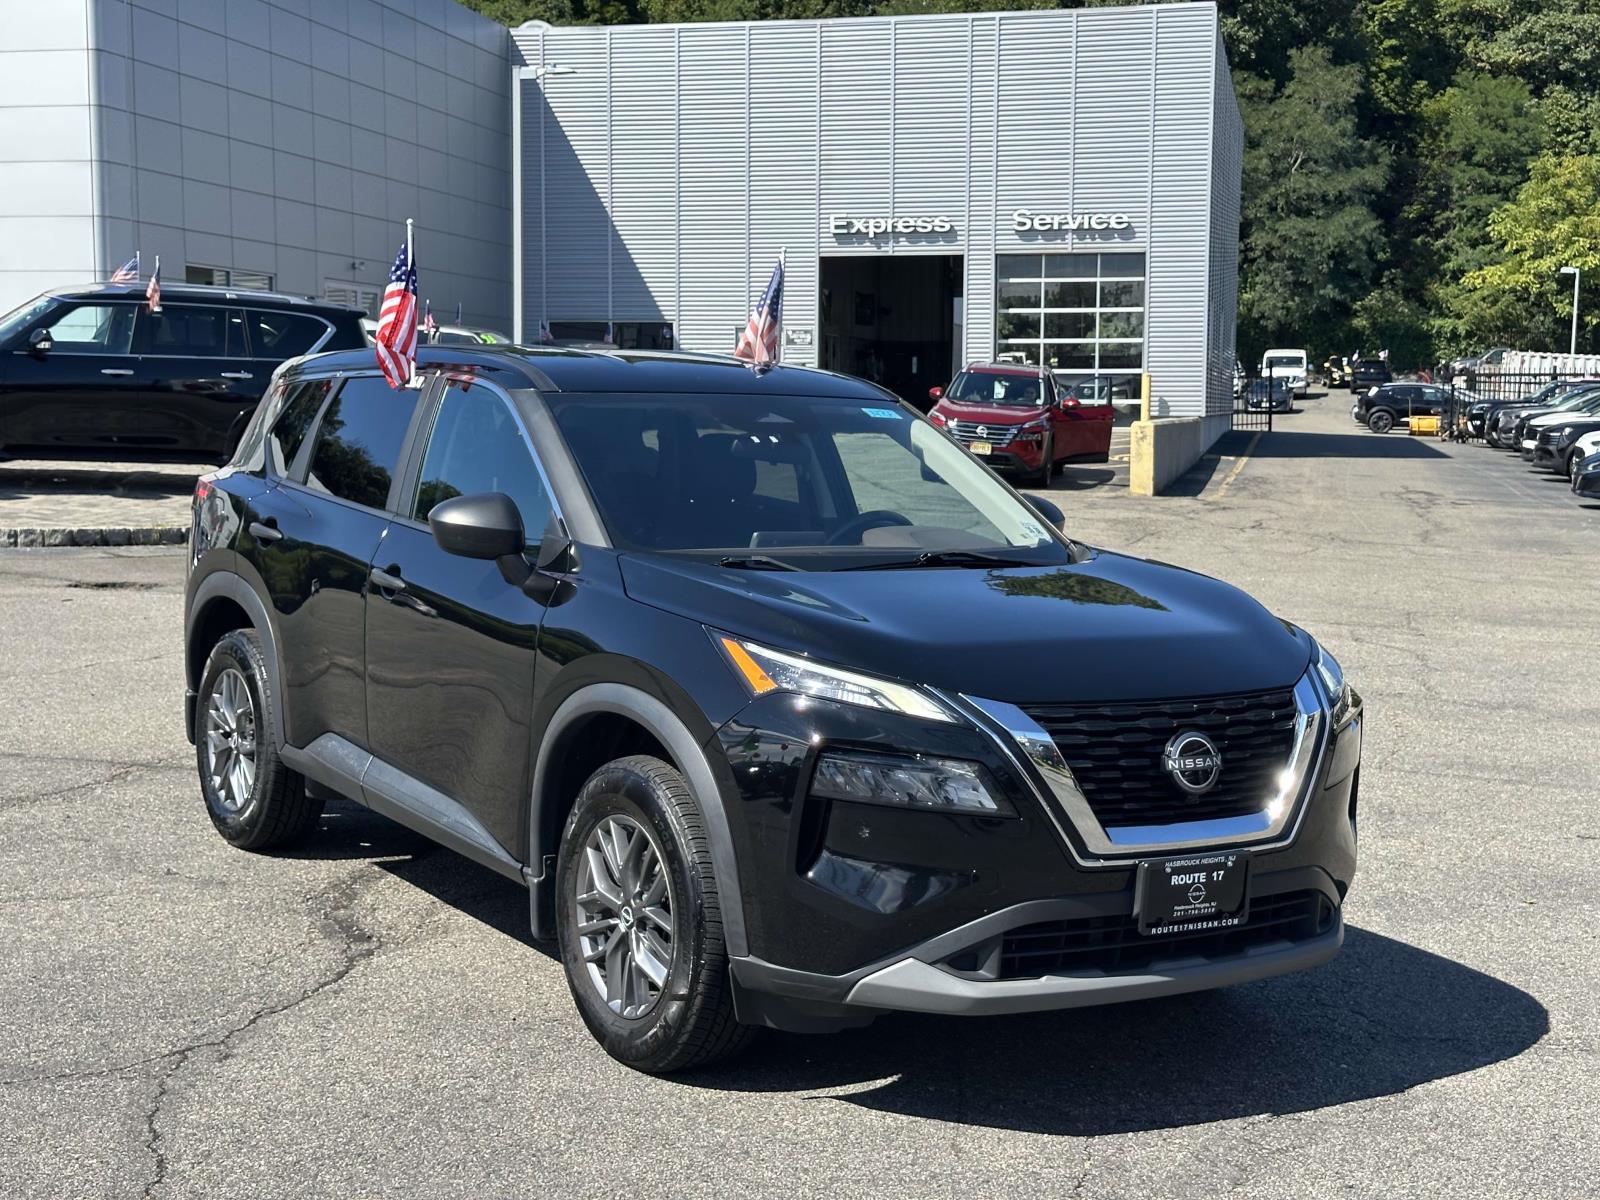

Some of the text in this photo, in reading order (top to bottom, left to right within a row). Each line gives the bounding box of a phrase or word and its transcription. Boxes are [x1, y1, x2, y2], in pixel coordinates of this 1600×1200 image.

[829, 213, 951, 238] Express
[1013, 209, 1129, 231] Service
[1168, 754, 1221, 769] NISSAN
[1165, 859, 1200, 867] HASBROUCK
[1171, 870, 1224, 885] ROUTE 17
[1151, 918, 1239, 934] ROUTE17NISSAN.COM
